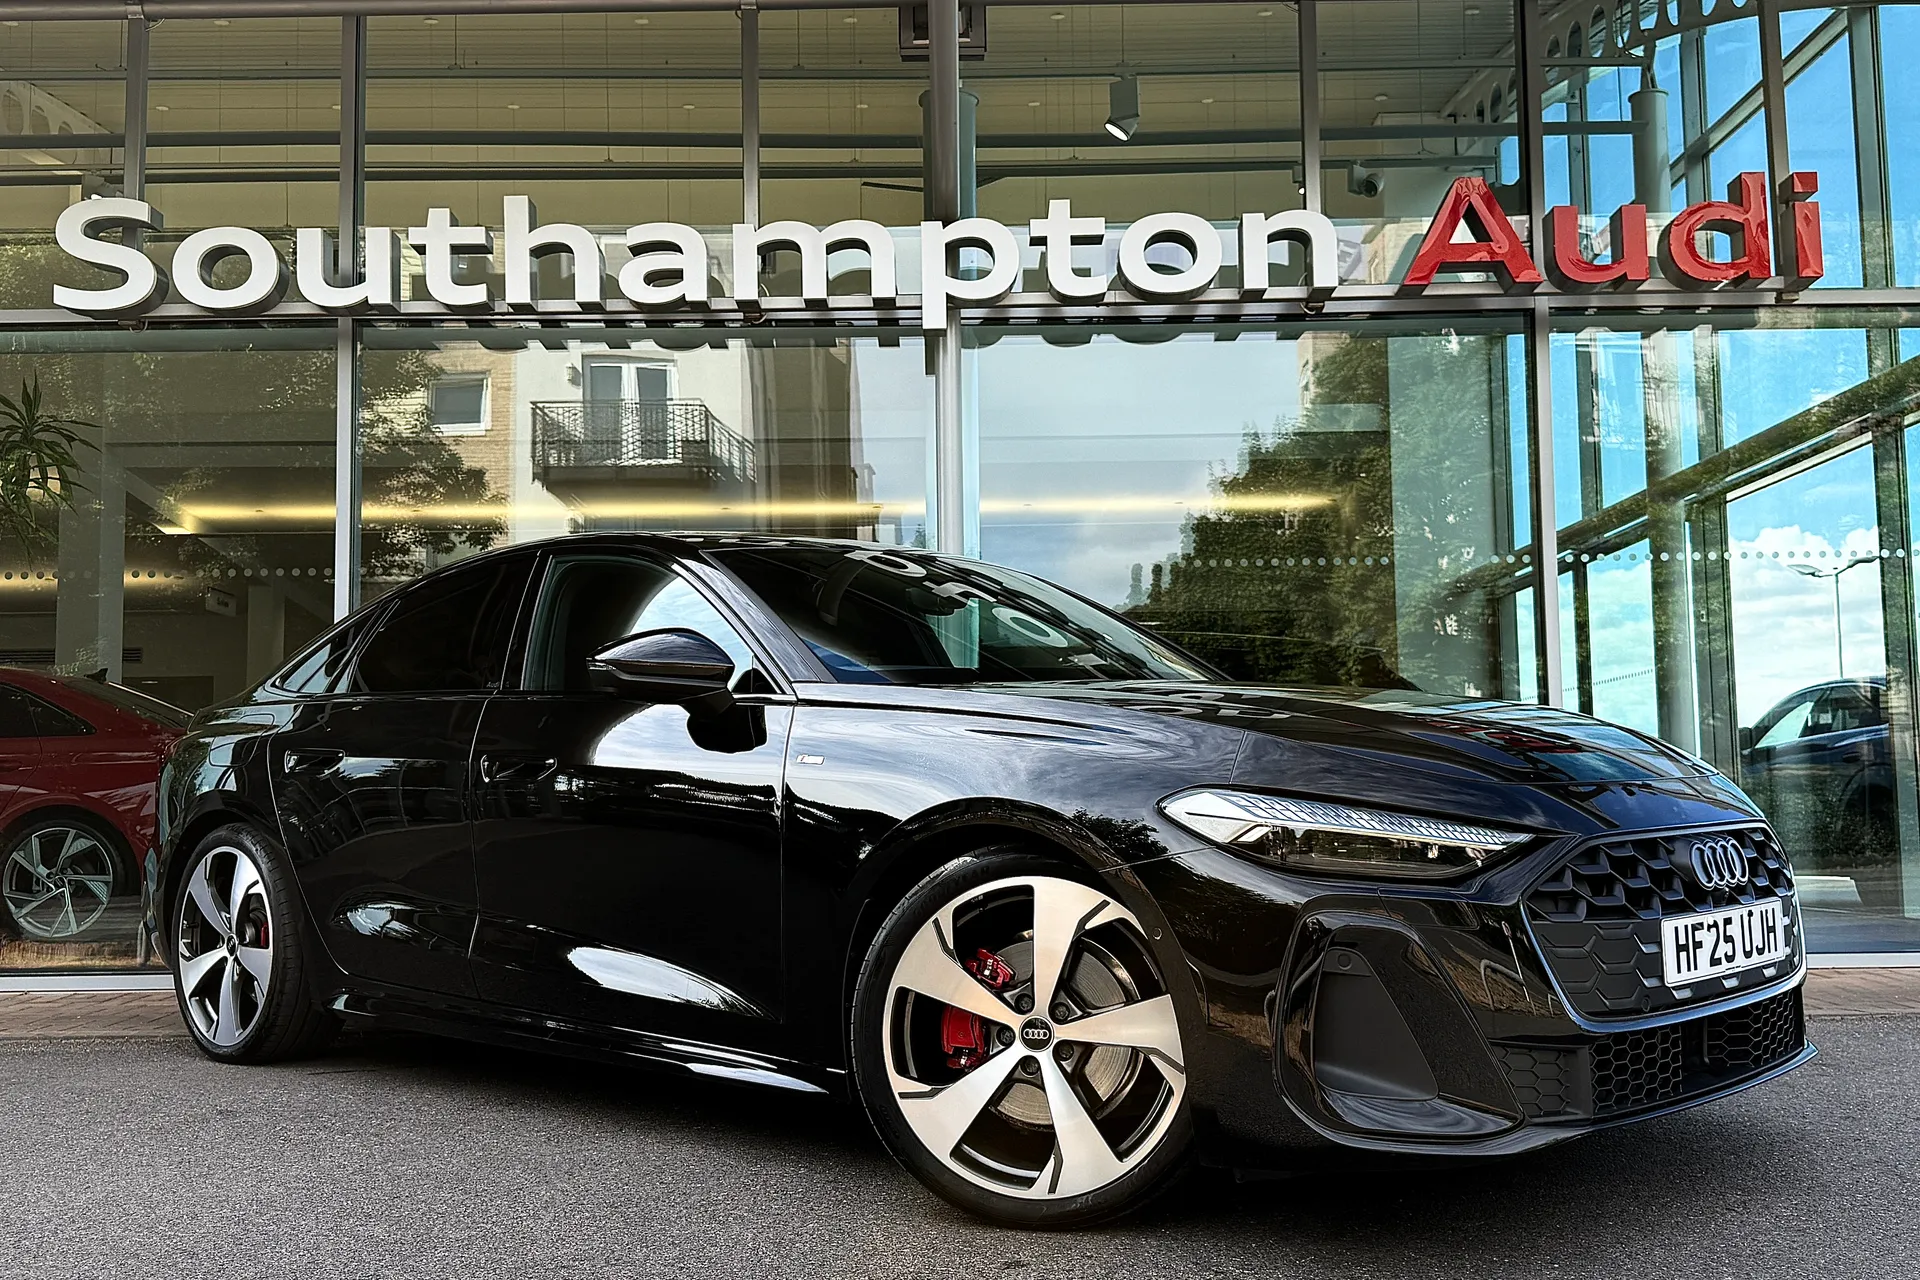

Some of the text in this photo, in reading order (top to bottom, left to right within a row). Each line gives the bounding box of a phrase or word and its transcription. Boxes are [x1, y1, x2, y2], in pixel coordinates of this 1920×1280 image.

[52, 171, 1824, 331] Southampton Audi
[1673, 907, 1778, 974] HF25 UJH
